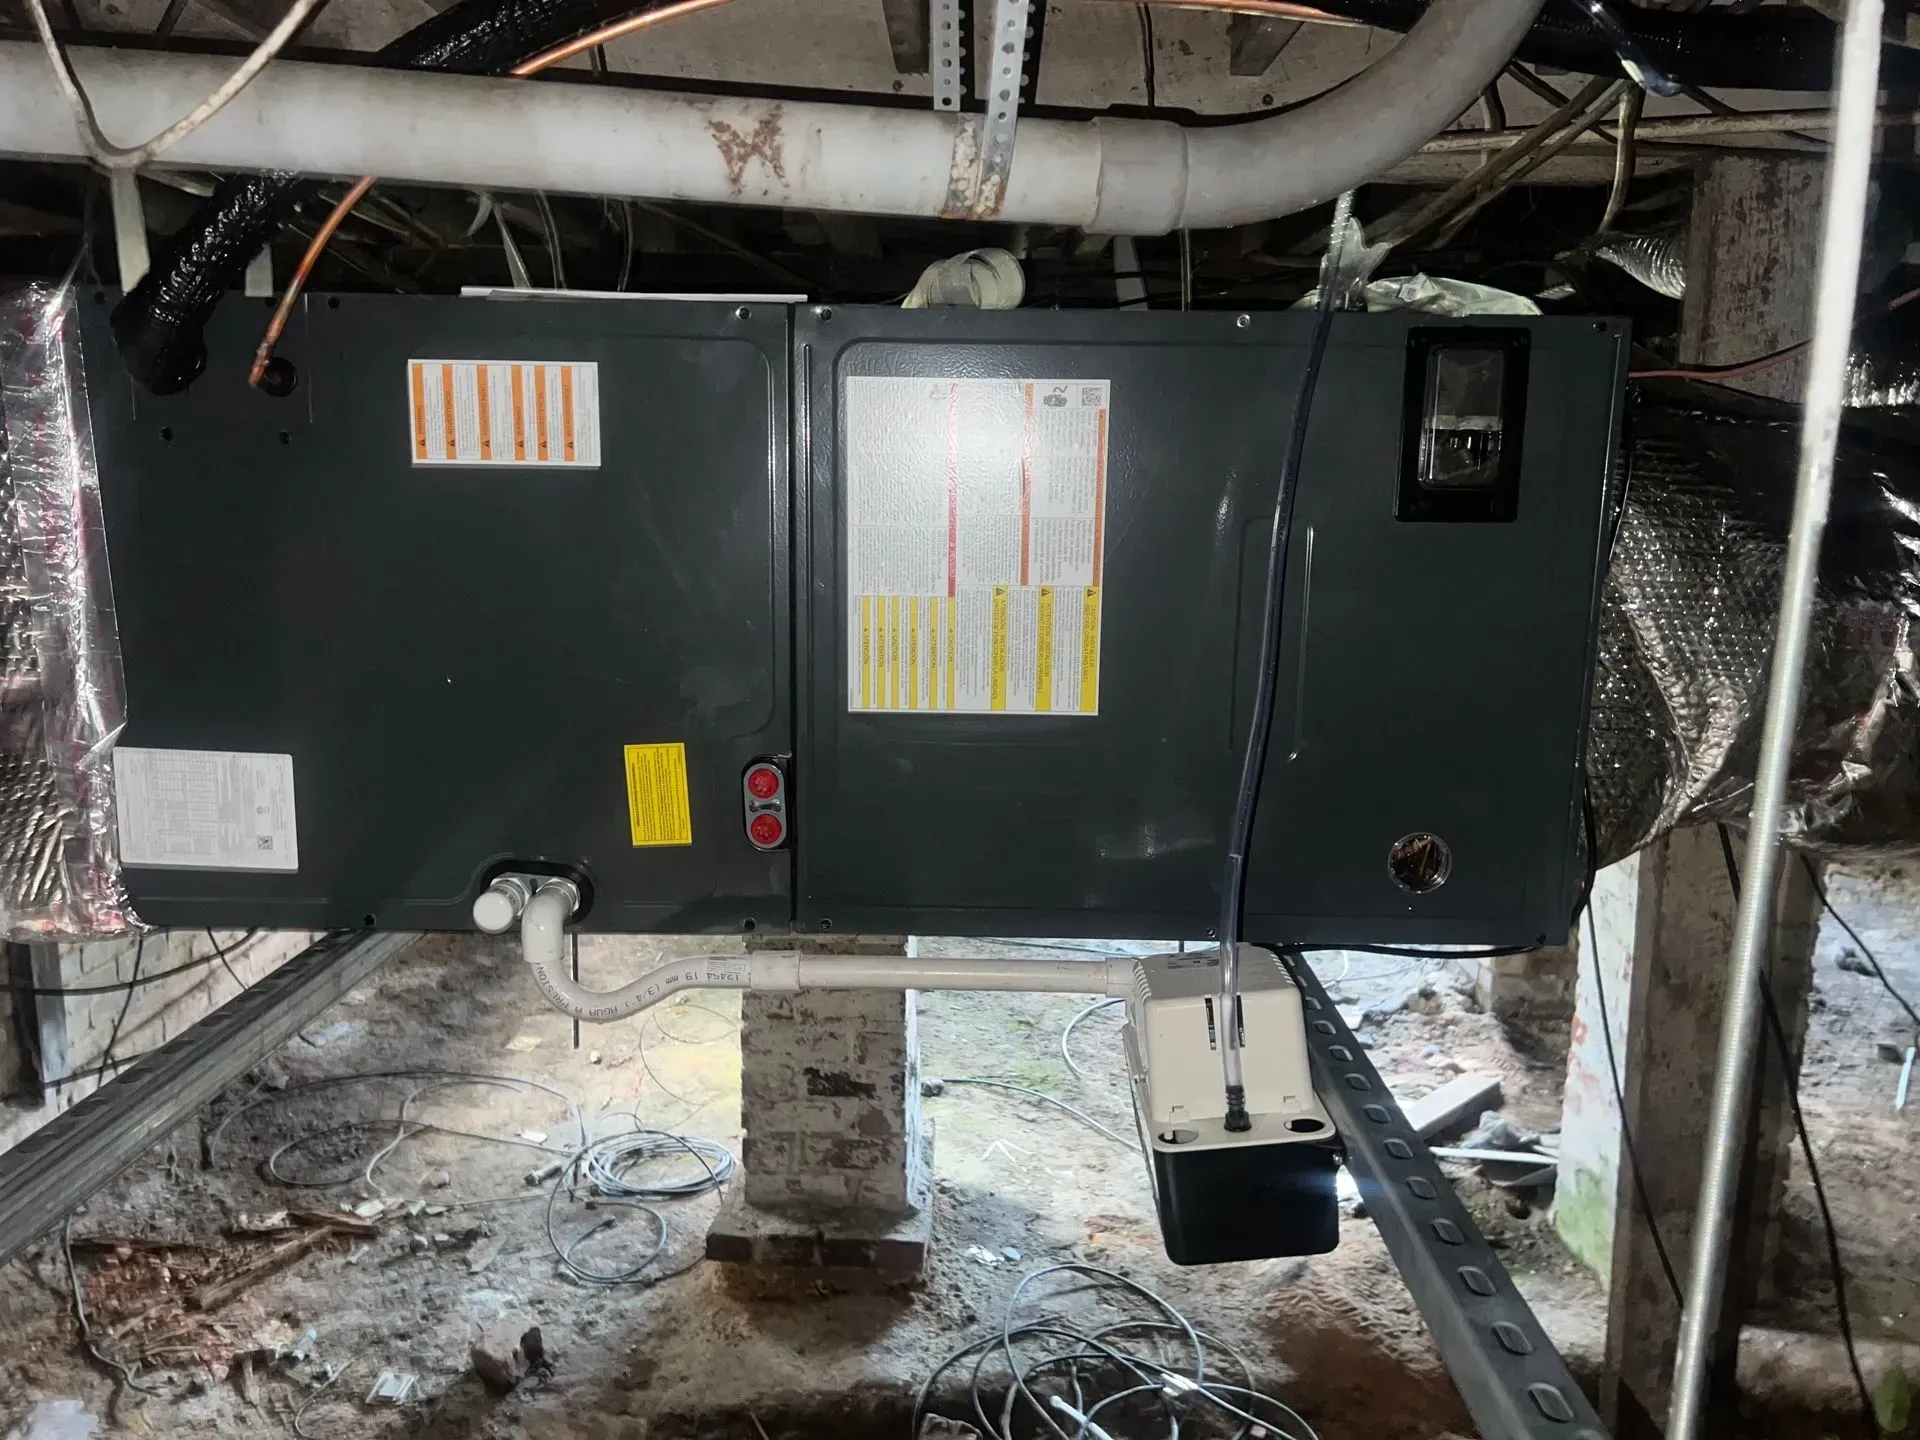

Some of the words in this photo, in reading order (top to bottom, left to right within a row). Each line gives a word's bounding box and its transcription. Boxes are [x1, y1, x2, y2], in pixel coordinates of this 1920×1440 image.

[664, 975, 678, 984] mm
[684, 971, 698, 981] 19
[574, 1006, 583, 1014] A
[589, 1005, 617, 1016] AGUA
